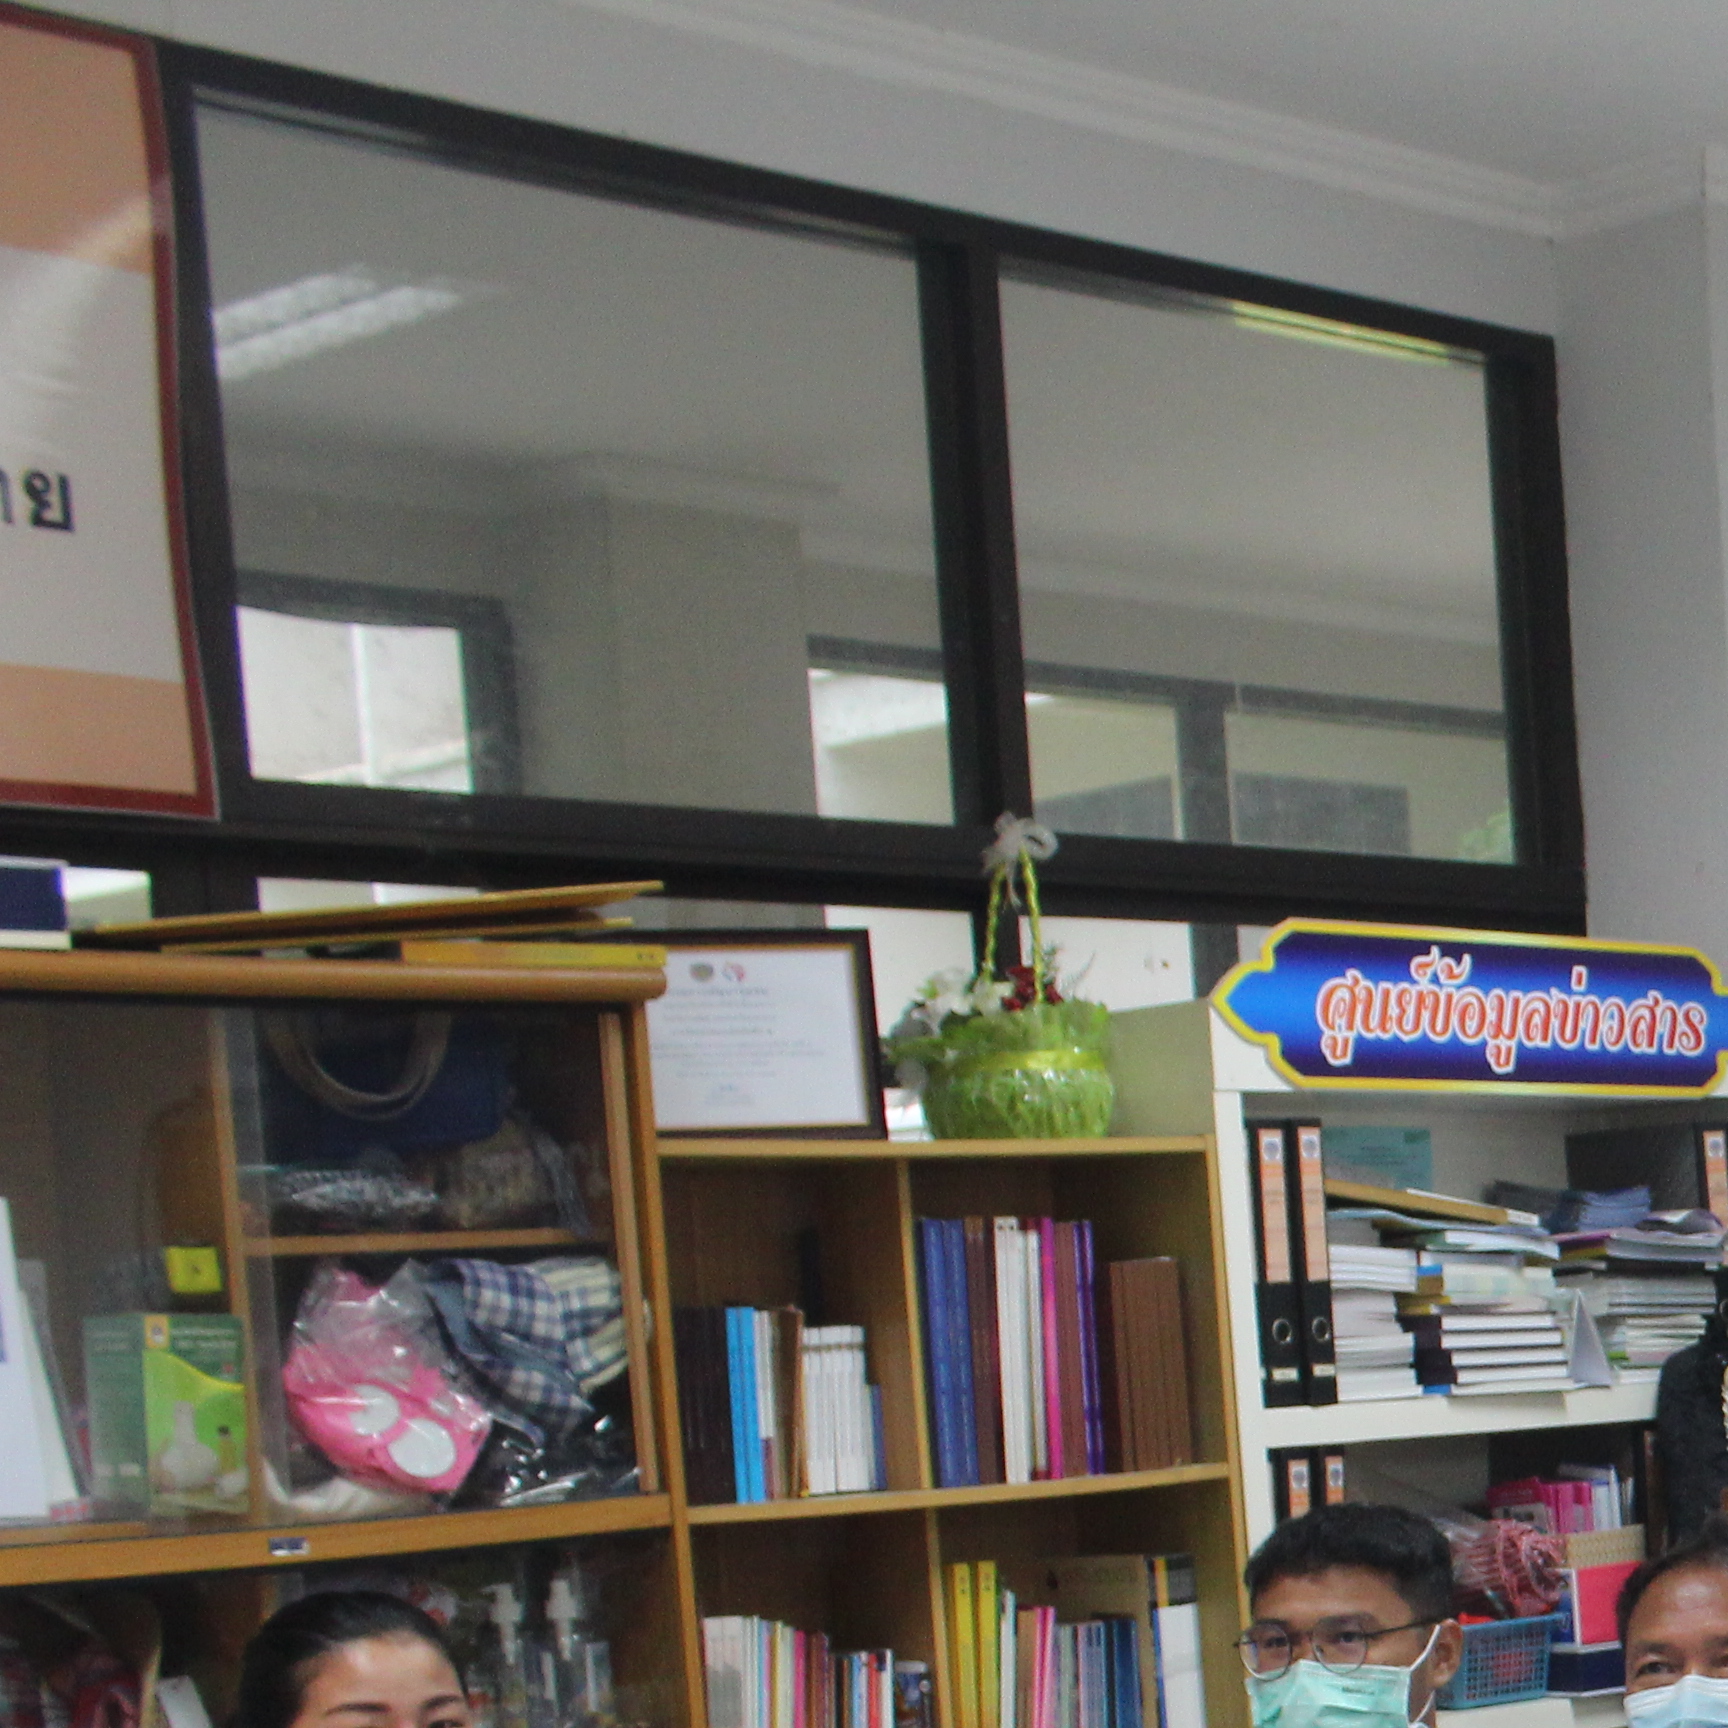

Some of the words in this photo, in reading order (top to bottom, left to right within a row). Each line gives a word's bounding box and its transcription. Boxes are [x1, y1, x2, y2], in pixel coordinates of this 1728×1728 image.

[1318, 946, 1706, 1074] ศูนย์ข้อมูลข่าวสาร
